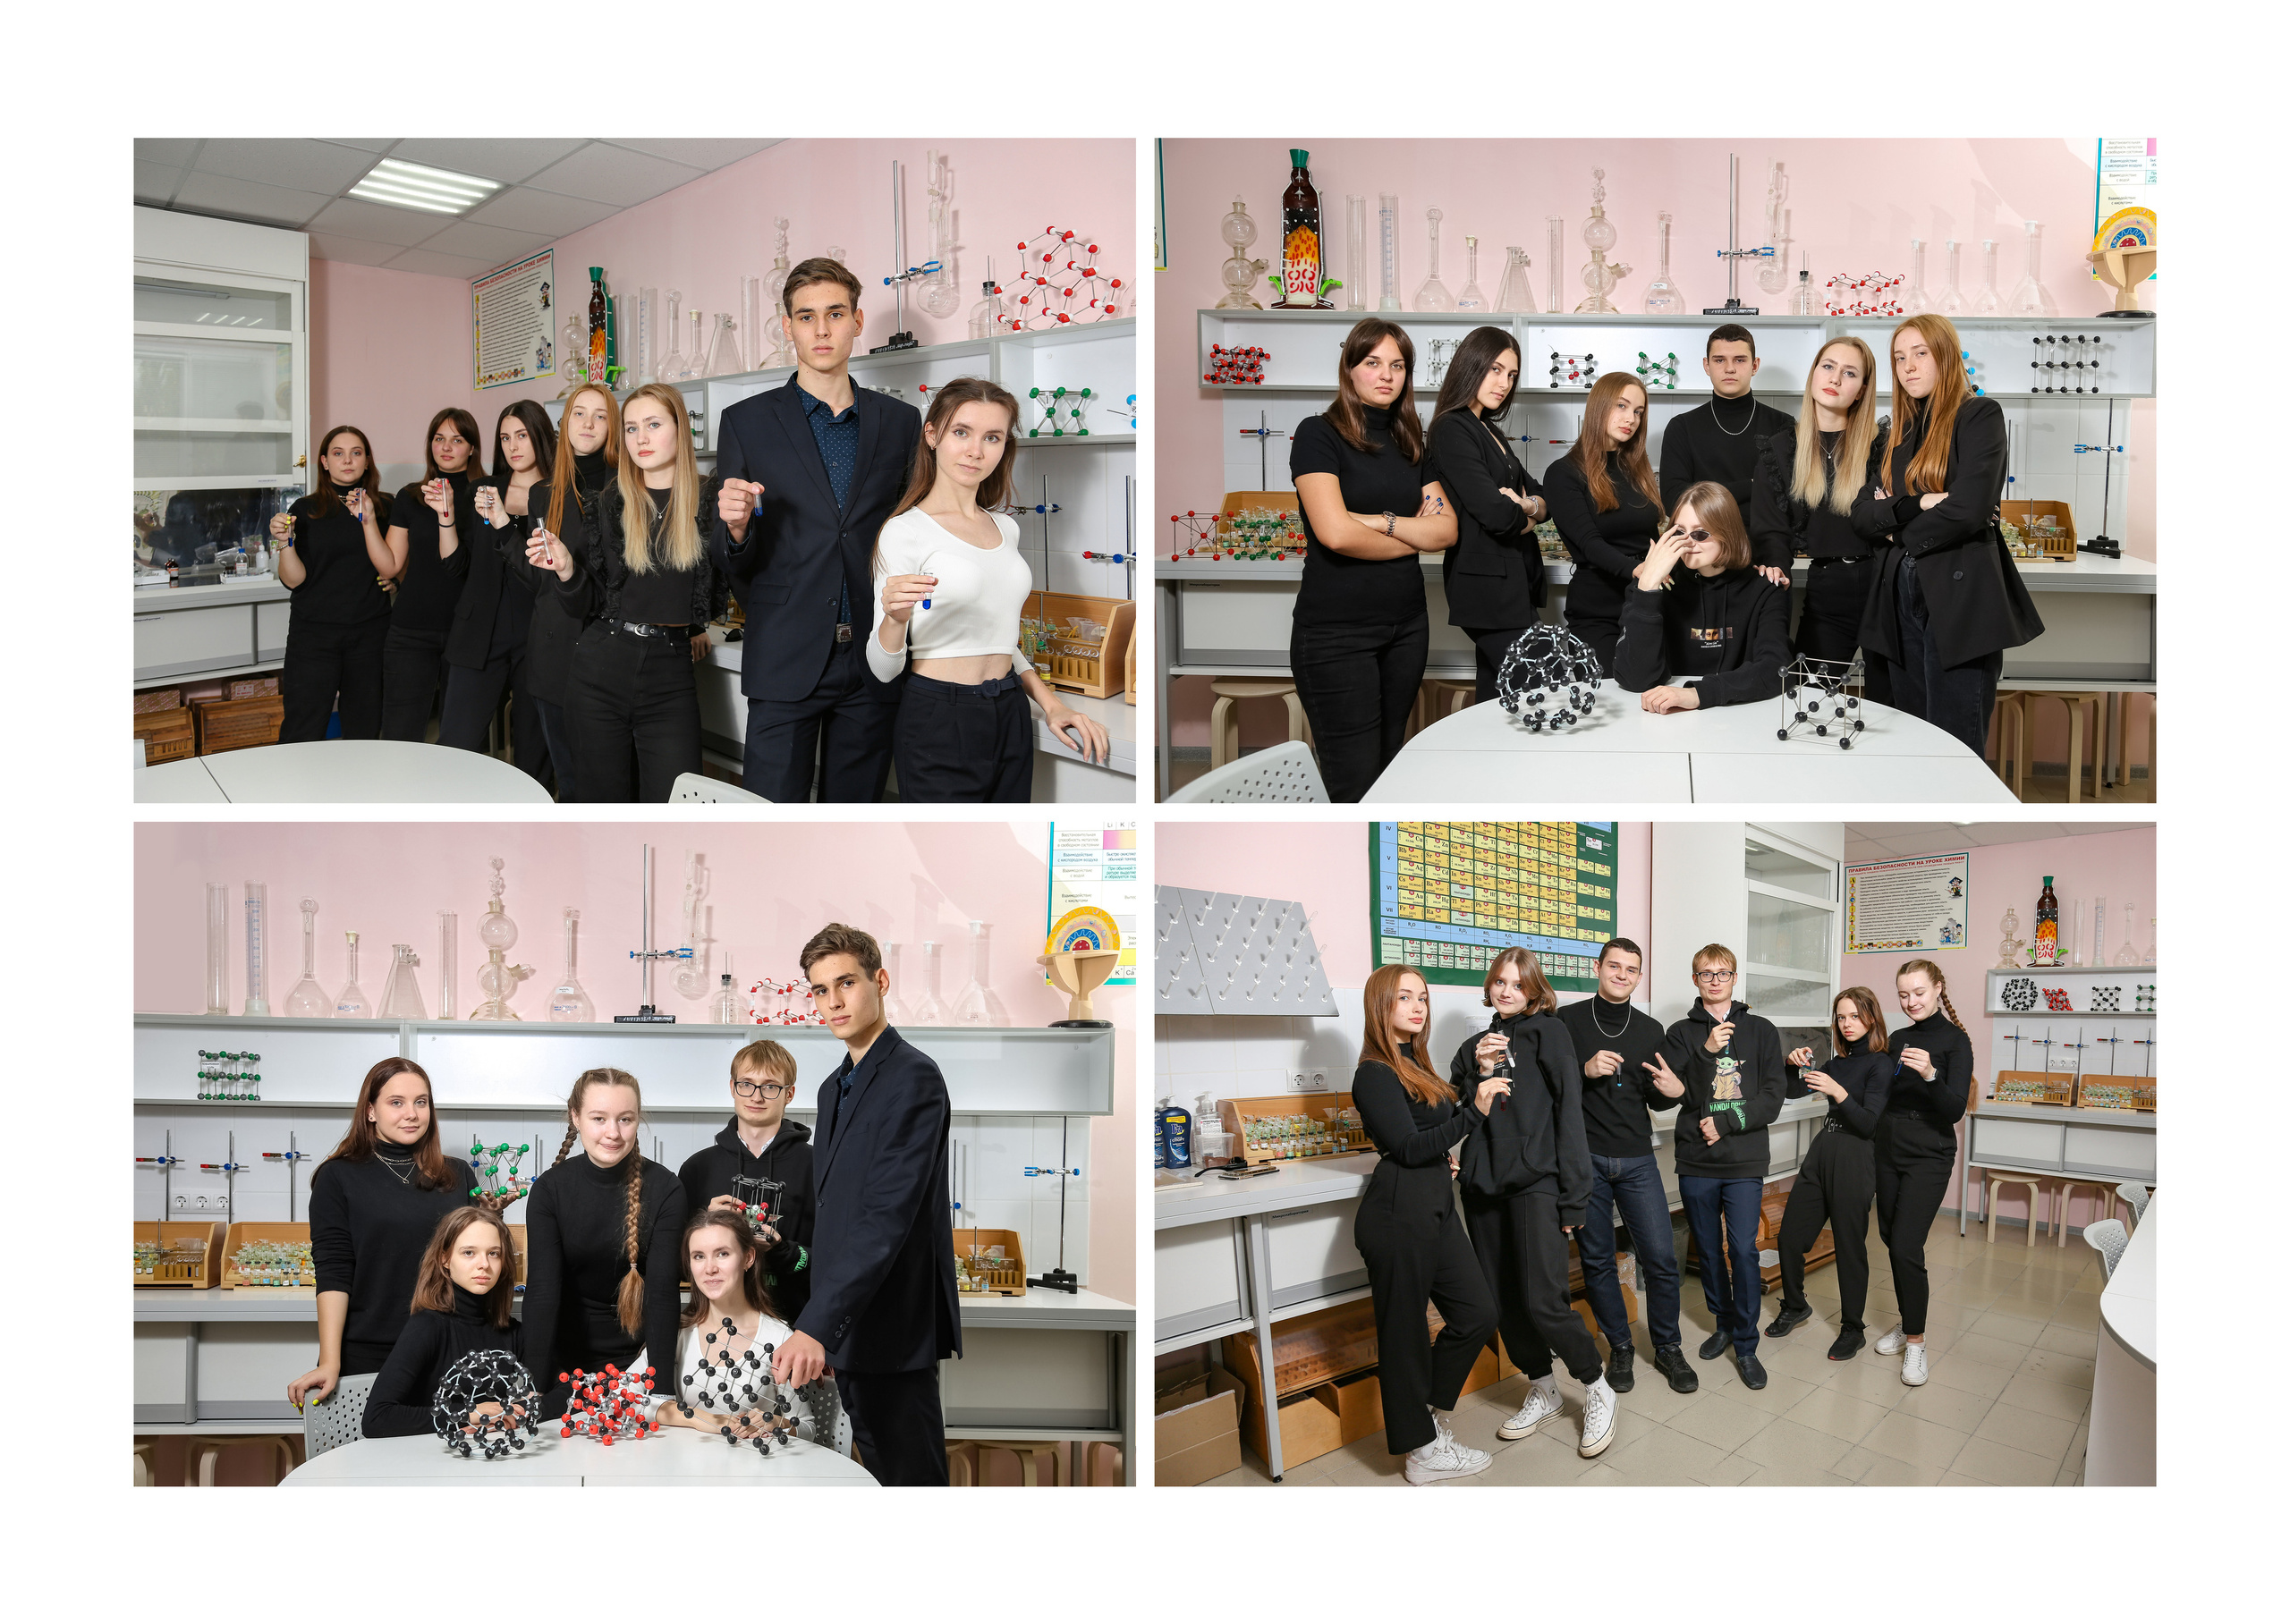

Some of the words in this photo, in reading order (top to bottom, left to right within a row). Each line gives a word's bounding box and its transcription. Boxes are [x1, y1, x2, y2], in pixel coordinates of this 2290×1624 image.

[524, 260, 535, 269] УРОКЕ
[1873, 861, 1915, 870] БЕЗОПАСНОСТИ
[1171, 1124, 1185, 1134] Fa
